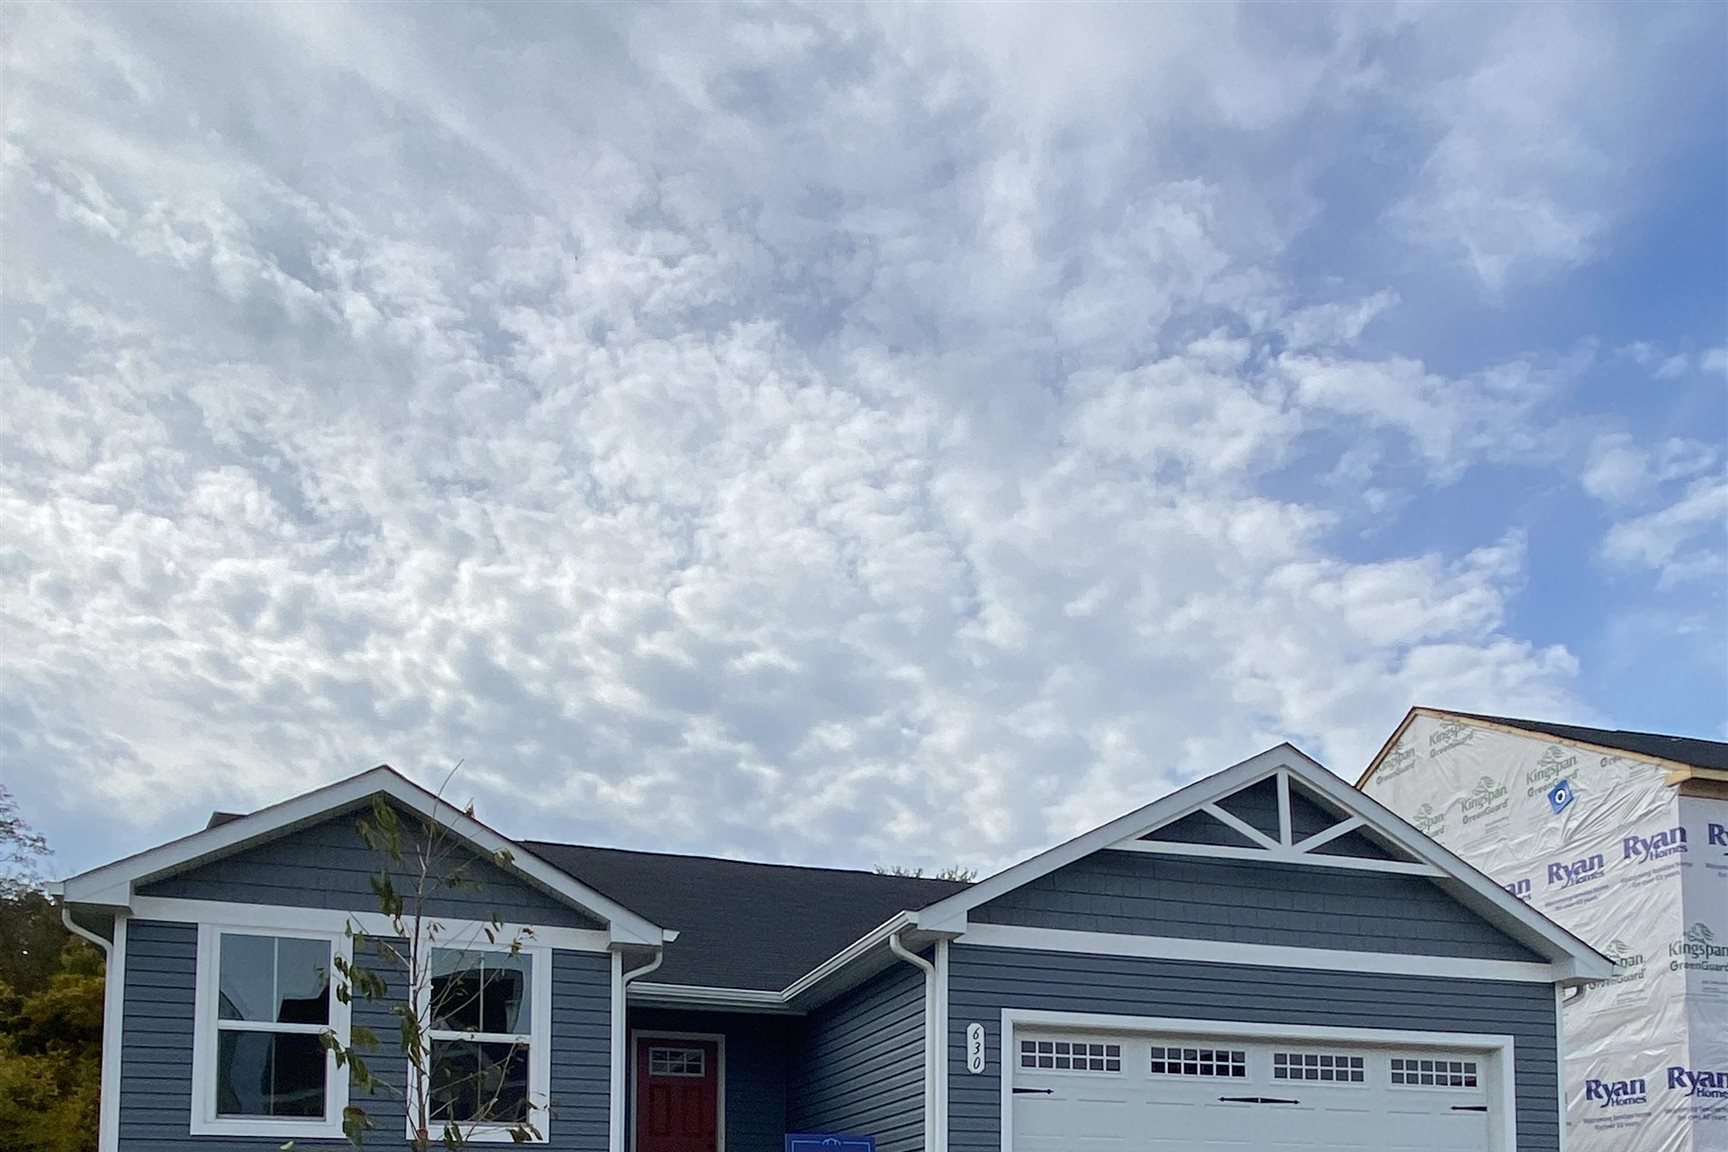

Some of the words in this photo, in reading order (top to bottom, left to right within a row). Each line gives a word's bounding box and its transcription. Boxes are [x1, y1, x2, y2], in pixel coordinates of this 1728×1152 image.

[1526, 755, 1577, 785] Kingspan
[1527, 769, 1579, 797] Greenard
[1461, 786, 1507, 812] Kingspan
[1623, 826, 1687, 865] Ryan
[1650, 845, 1688, 861] Homes
[1547, 854, 1604, 889] Ryan
[1571, 871, 1605, 886] Homes
[1668, 941, 1728, 959] Kingspan
[972, 1026, 982, 1070] 630
[1585, 1078, 1646, 1108] Ryan
[1667, 1066, 1728, 1097] Ryan
[1696, 1087, 1728, 1099] Home
[1610, 1096, 1647, 1107] Homes
